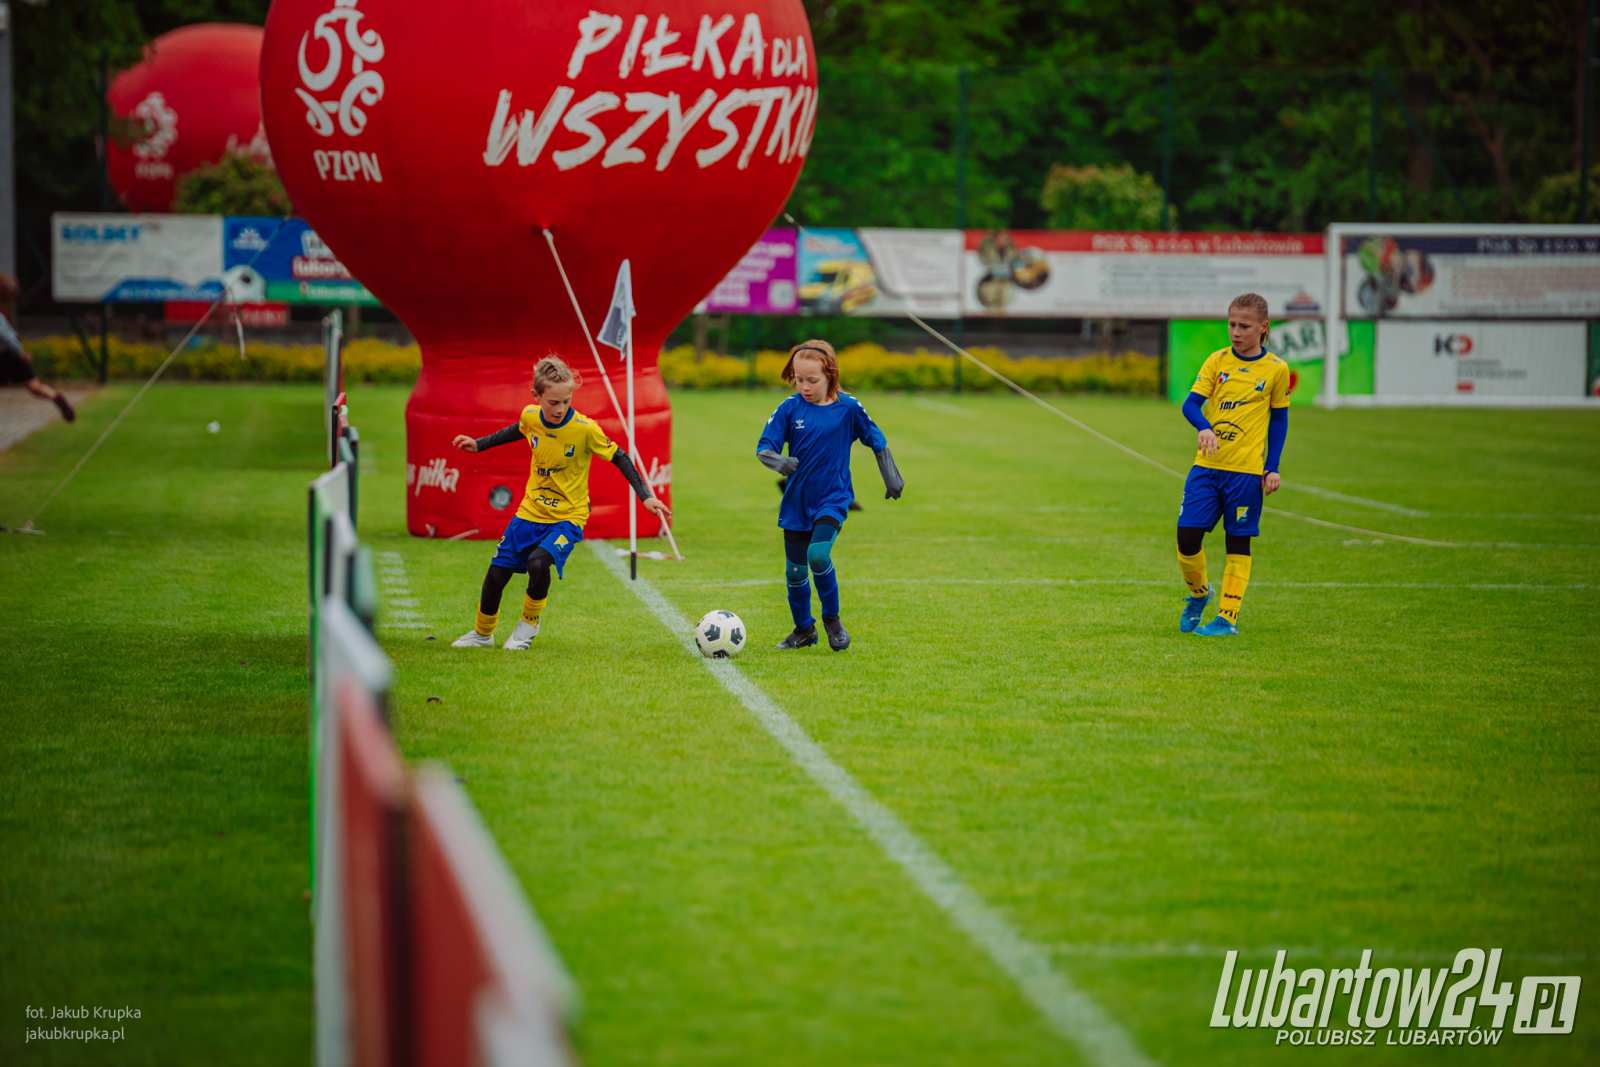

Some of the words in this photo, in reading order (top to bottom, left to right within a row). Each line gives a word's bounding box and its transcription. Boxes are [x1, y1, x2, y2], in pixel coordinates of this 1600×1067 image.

[567, 11, 764, 80] PIŁKA
[771, 36, 808, 80] DLA
[483, 85, 819, 171] WSZYSTKI
[313, 149, 382, 183] PZPN
